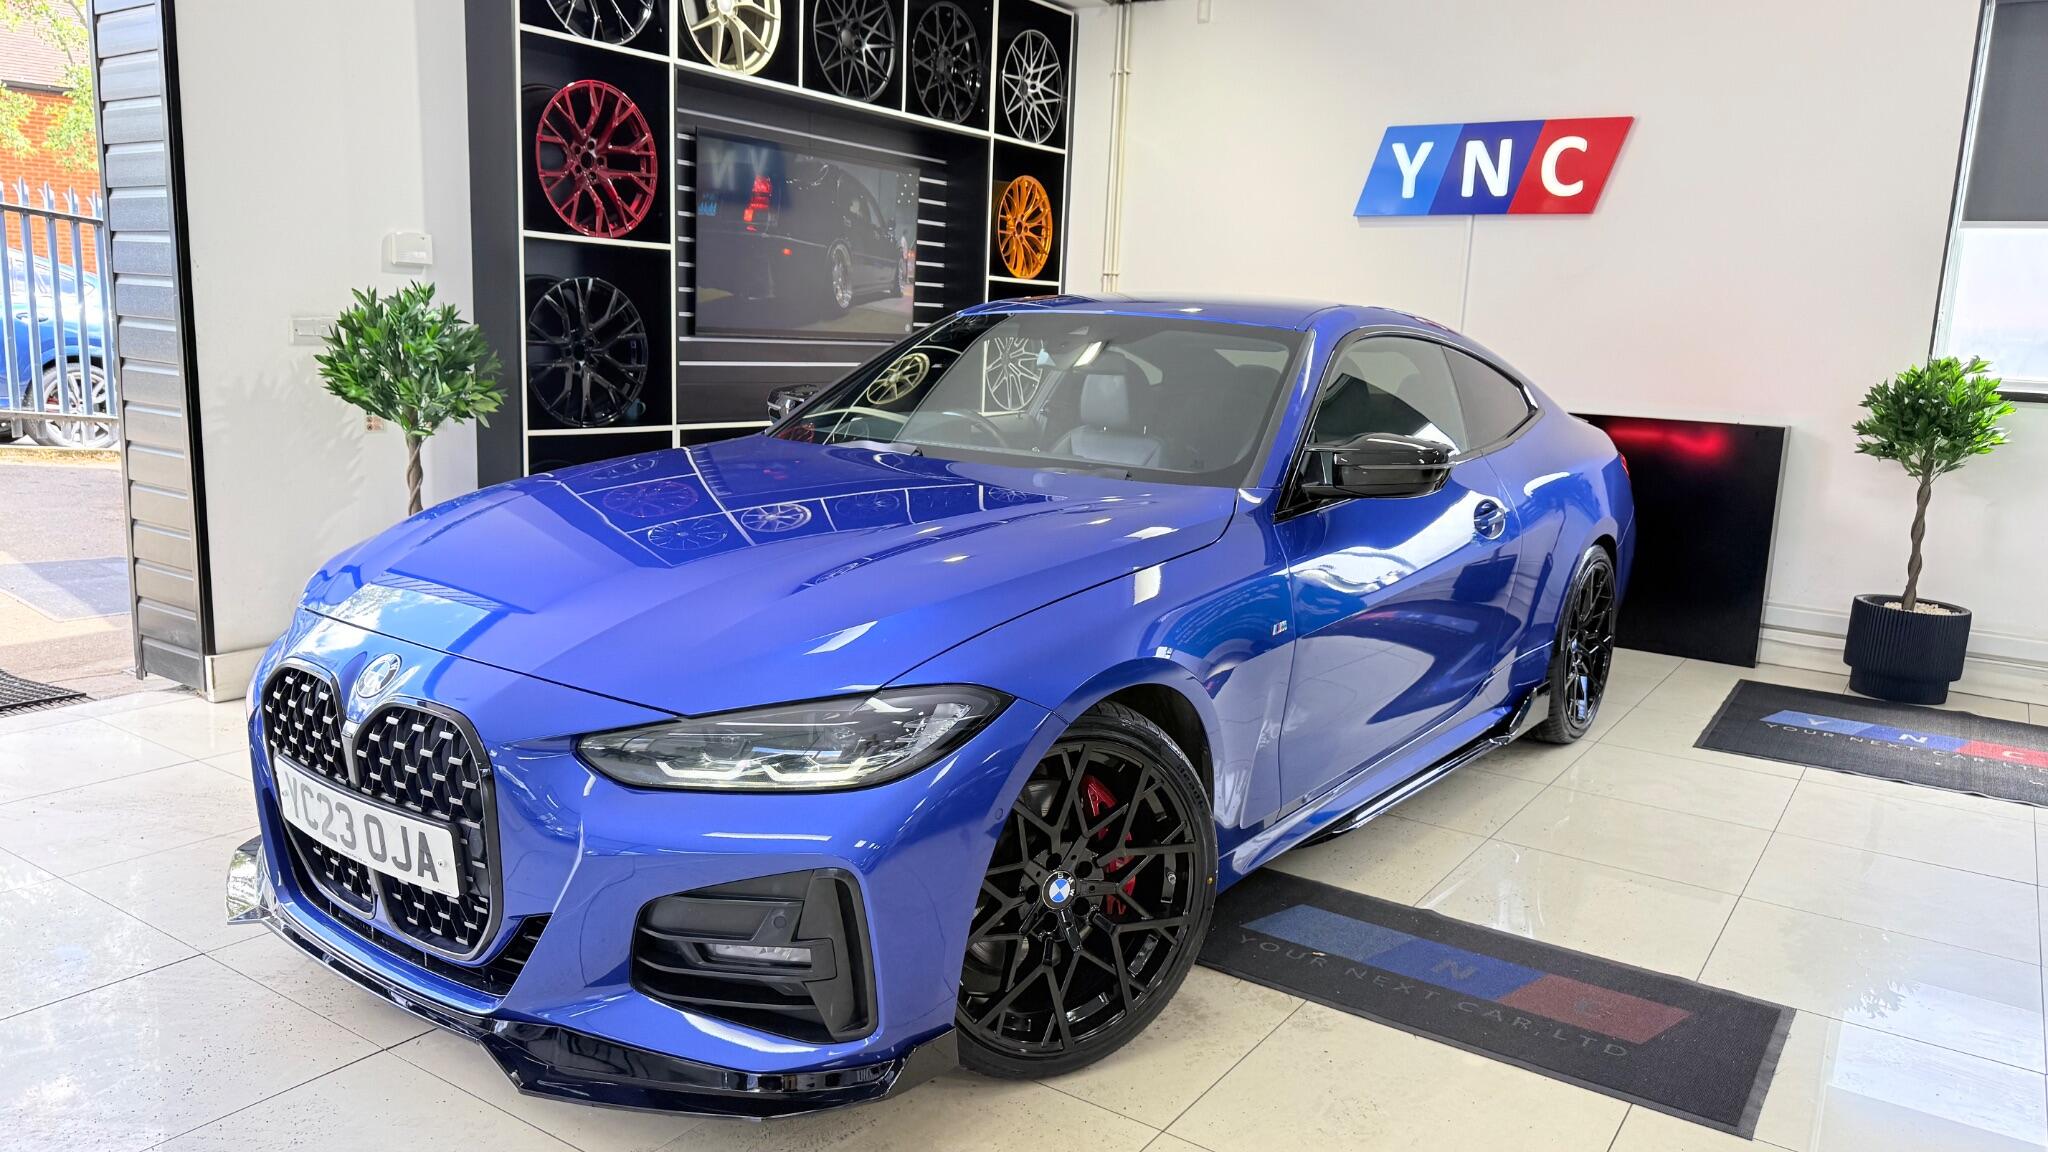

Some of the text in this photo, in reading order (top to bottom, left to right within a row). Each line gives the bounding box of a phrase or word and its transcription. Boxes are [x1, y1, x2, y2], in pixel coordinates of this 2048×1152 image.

[1392, 136, 1588, 199] YNC
[1766, 723, 1834, 738] YOUR
[1850, 736, 1918, 751] NEXT
[285, 771, 439, 883] YC23 OJA
[1240, 934, 1328, 968] YOUR
[1345, 967, 1440, 1001] NEXT
[1551, 1028, 1628, 1057] LTD
